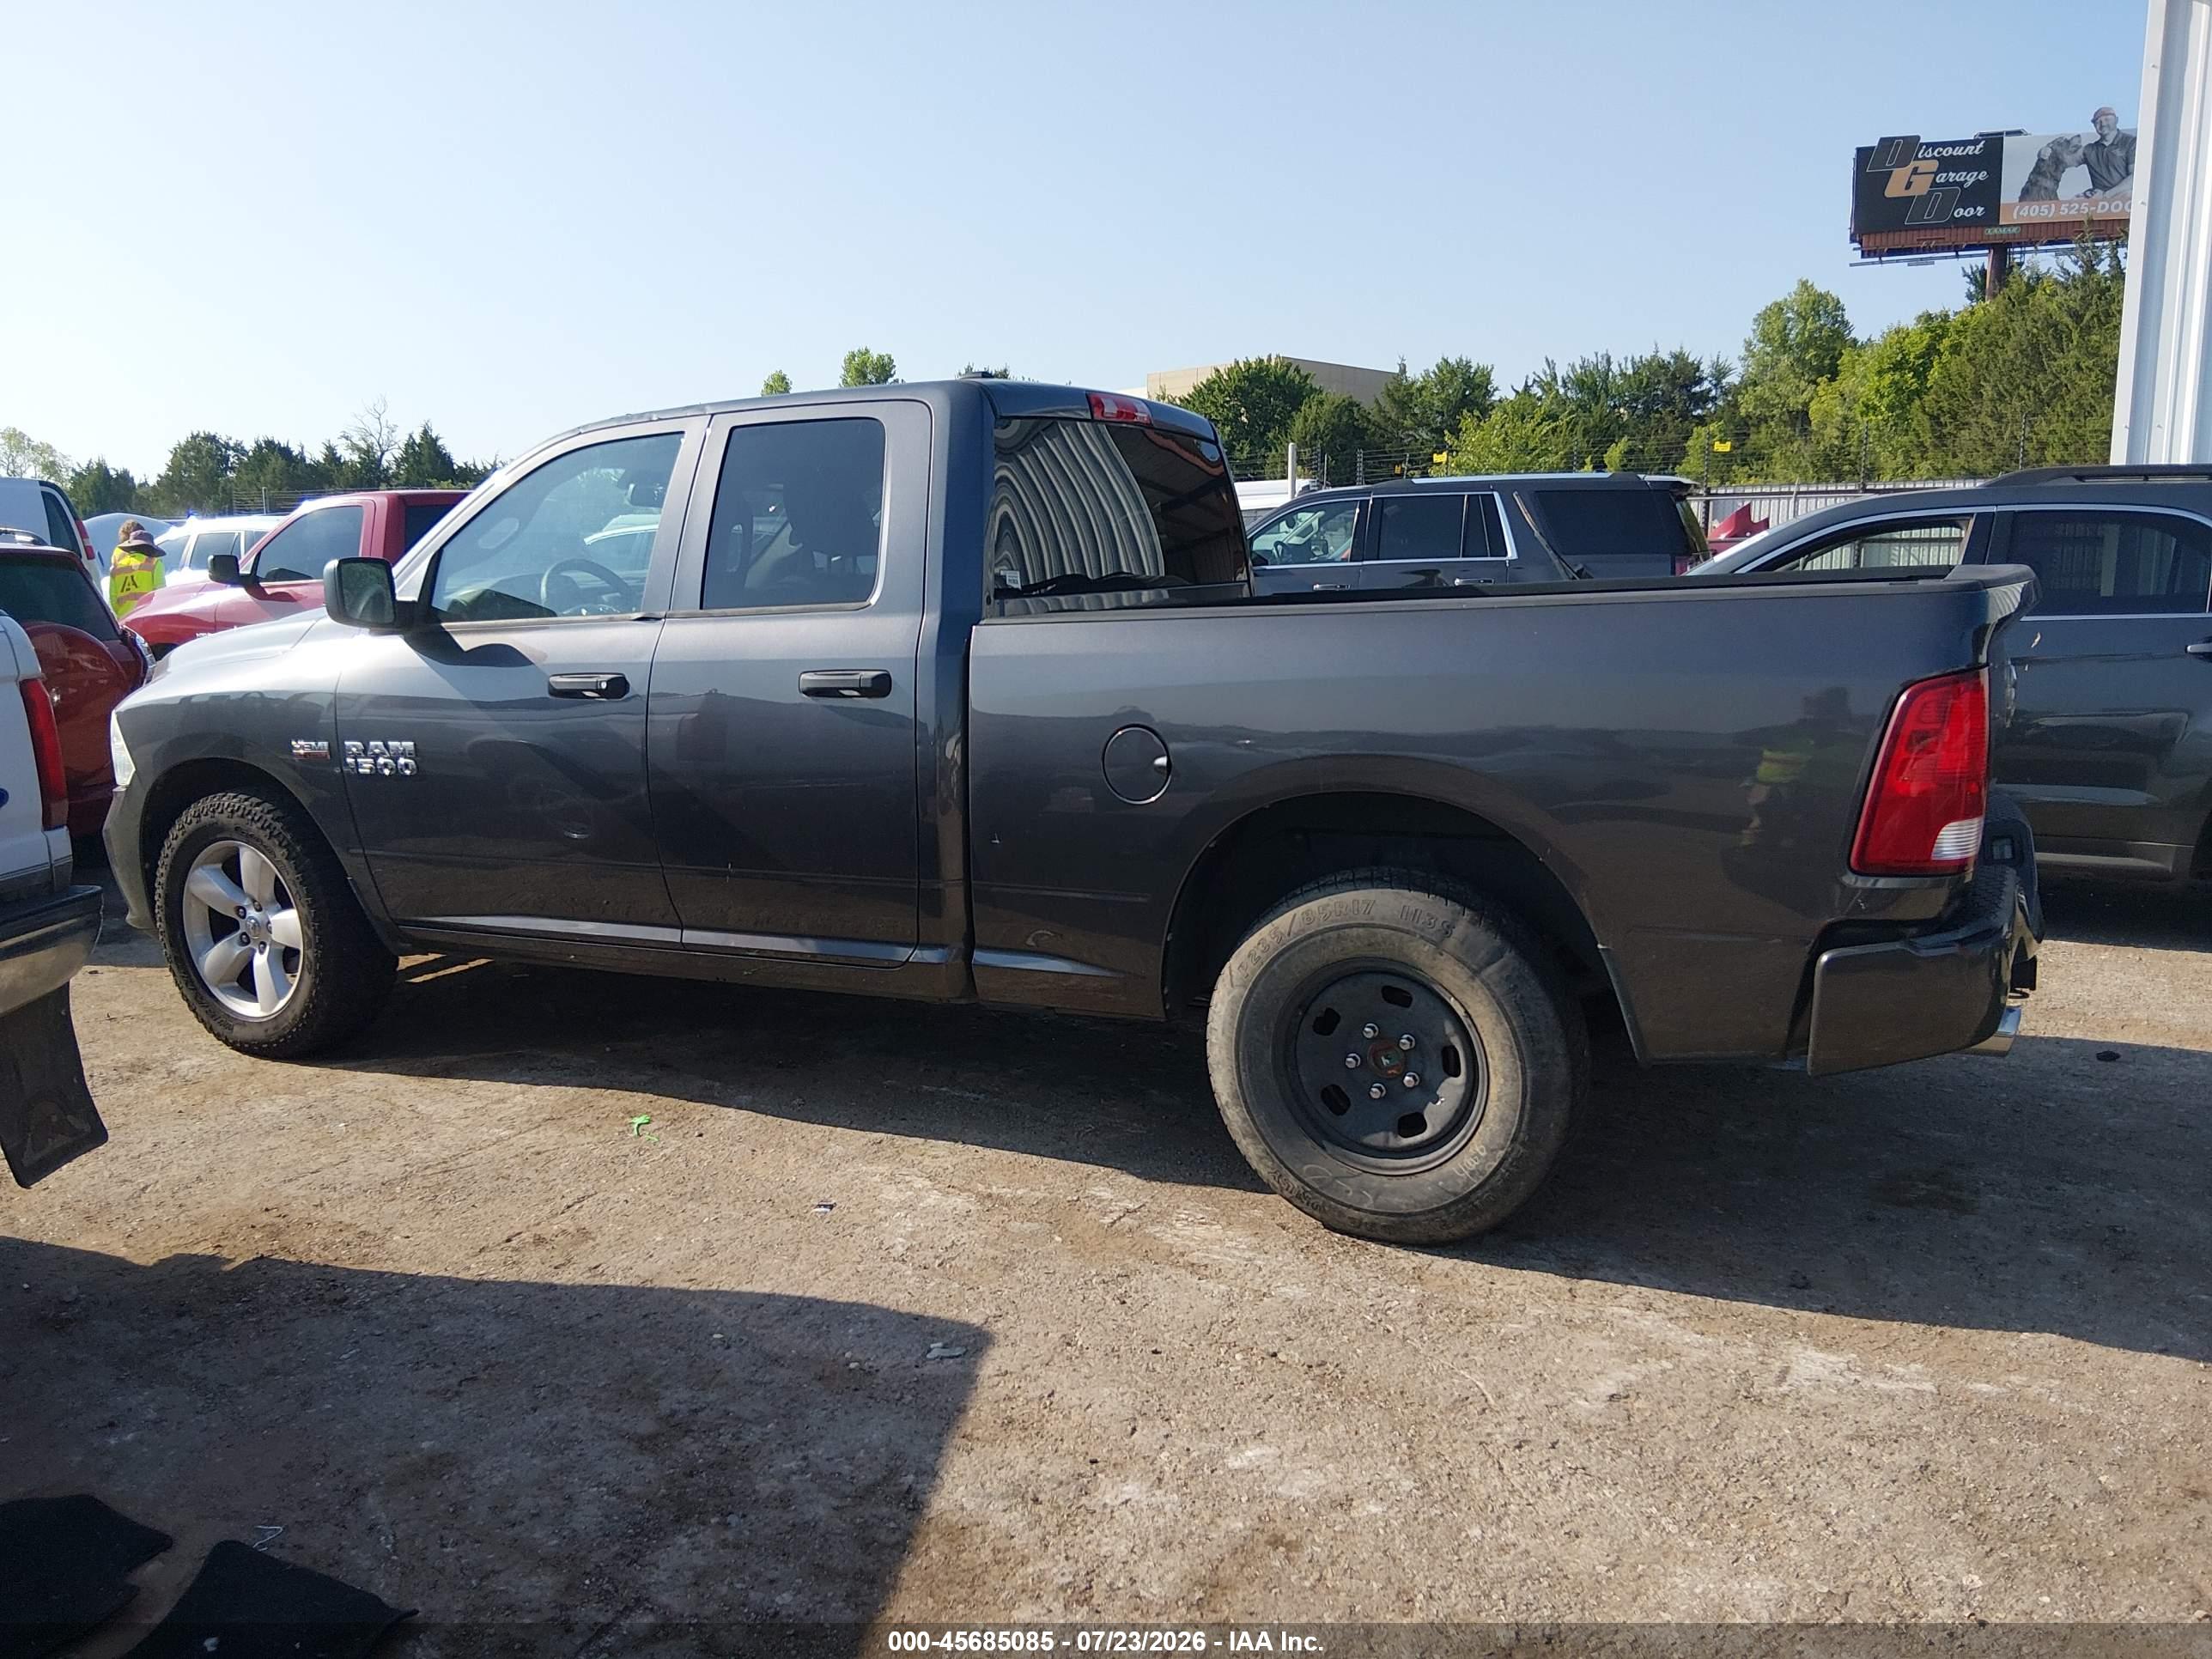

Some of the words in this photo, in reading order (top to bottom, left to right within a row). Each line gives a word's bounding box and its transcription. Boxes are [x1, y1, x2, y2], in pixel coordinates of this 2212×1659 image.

[1866, 135, 1985, 172] Discount
[1884, 159, 1989, 198] Garage
[1905, 186, 1985, 224] Door
[2013, 204, 2055, 220] (405)
[344, 741, 416, 757] RAM
[345, 757, 417, 775] 1500
